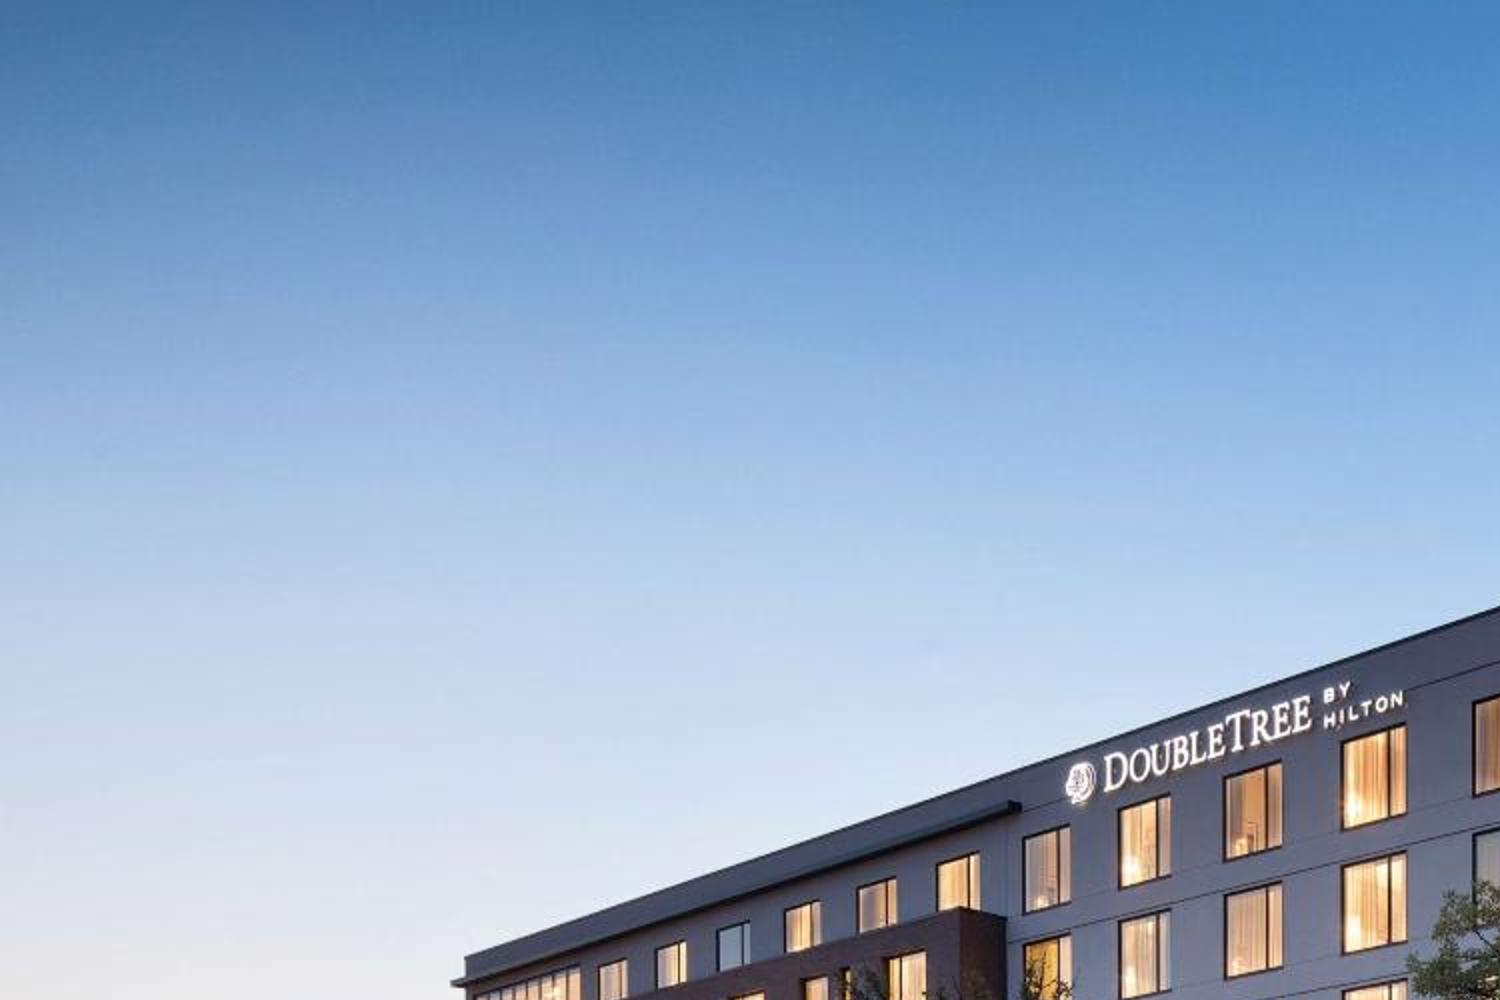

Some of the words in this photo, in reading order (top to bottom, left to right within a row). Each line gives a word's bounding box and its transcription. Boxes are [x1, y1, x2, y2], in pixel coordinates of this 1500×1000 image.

[1323, 681, 1351, 704] BY
[1323, 690, 1403, 729] HILTON
[1103, 695, 1313, 792] DOUBLETREE
